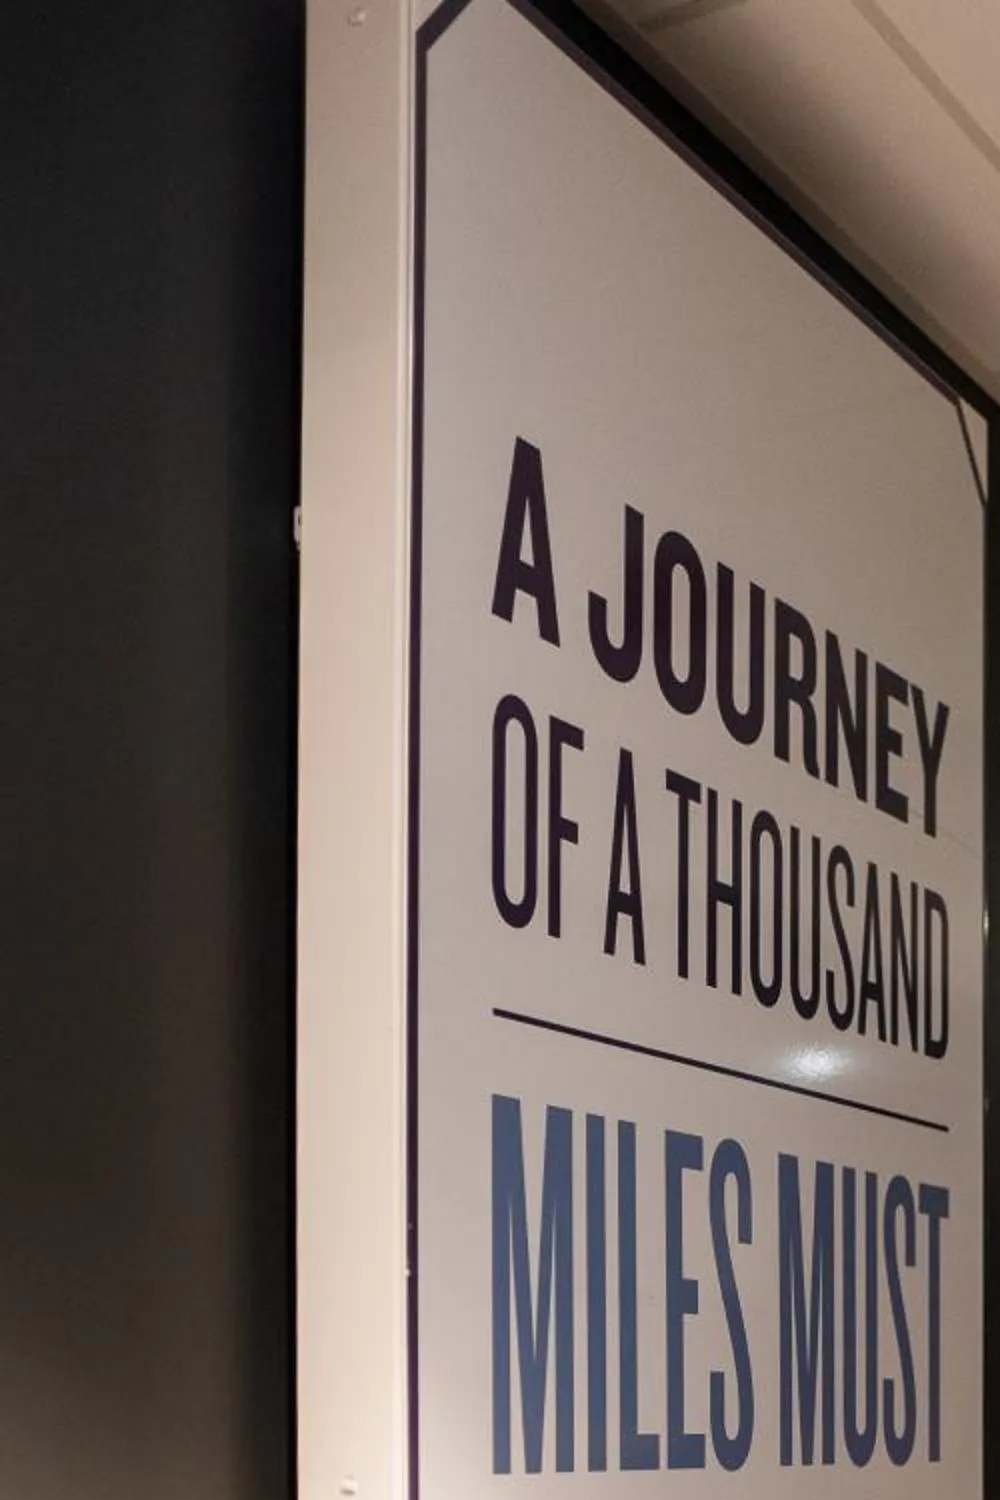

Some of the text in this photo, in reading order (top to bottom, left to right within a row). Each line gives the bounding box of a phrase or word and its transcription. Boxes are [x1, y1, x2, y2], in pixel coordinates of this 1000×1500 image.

[491, 436, 950, 838] A JOURNEY
[492, 694, 949, 1060] OF A THOUSAND
[492, 1094, 949, 1474] MILES MUST
